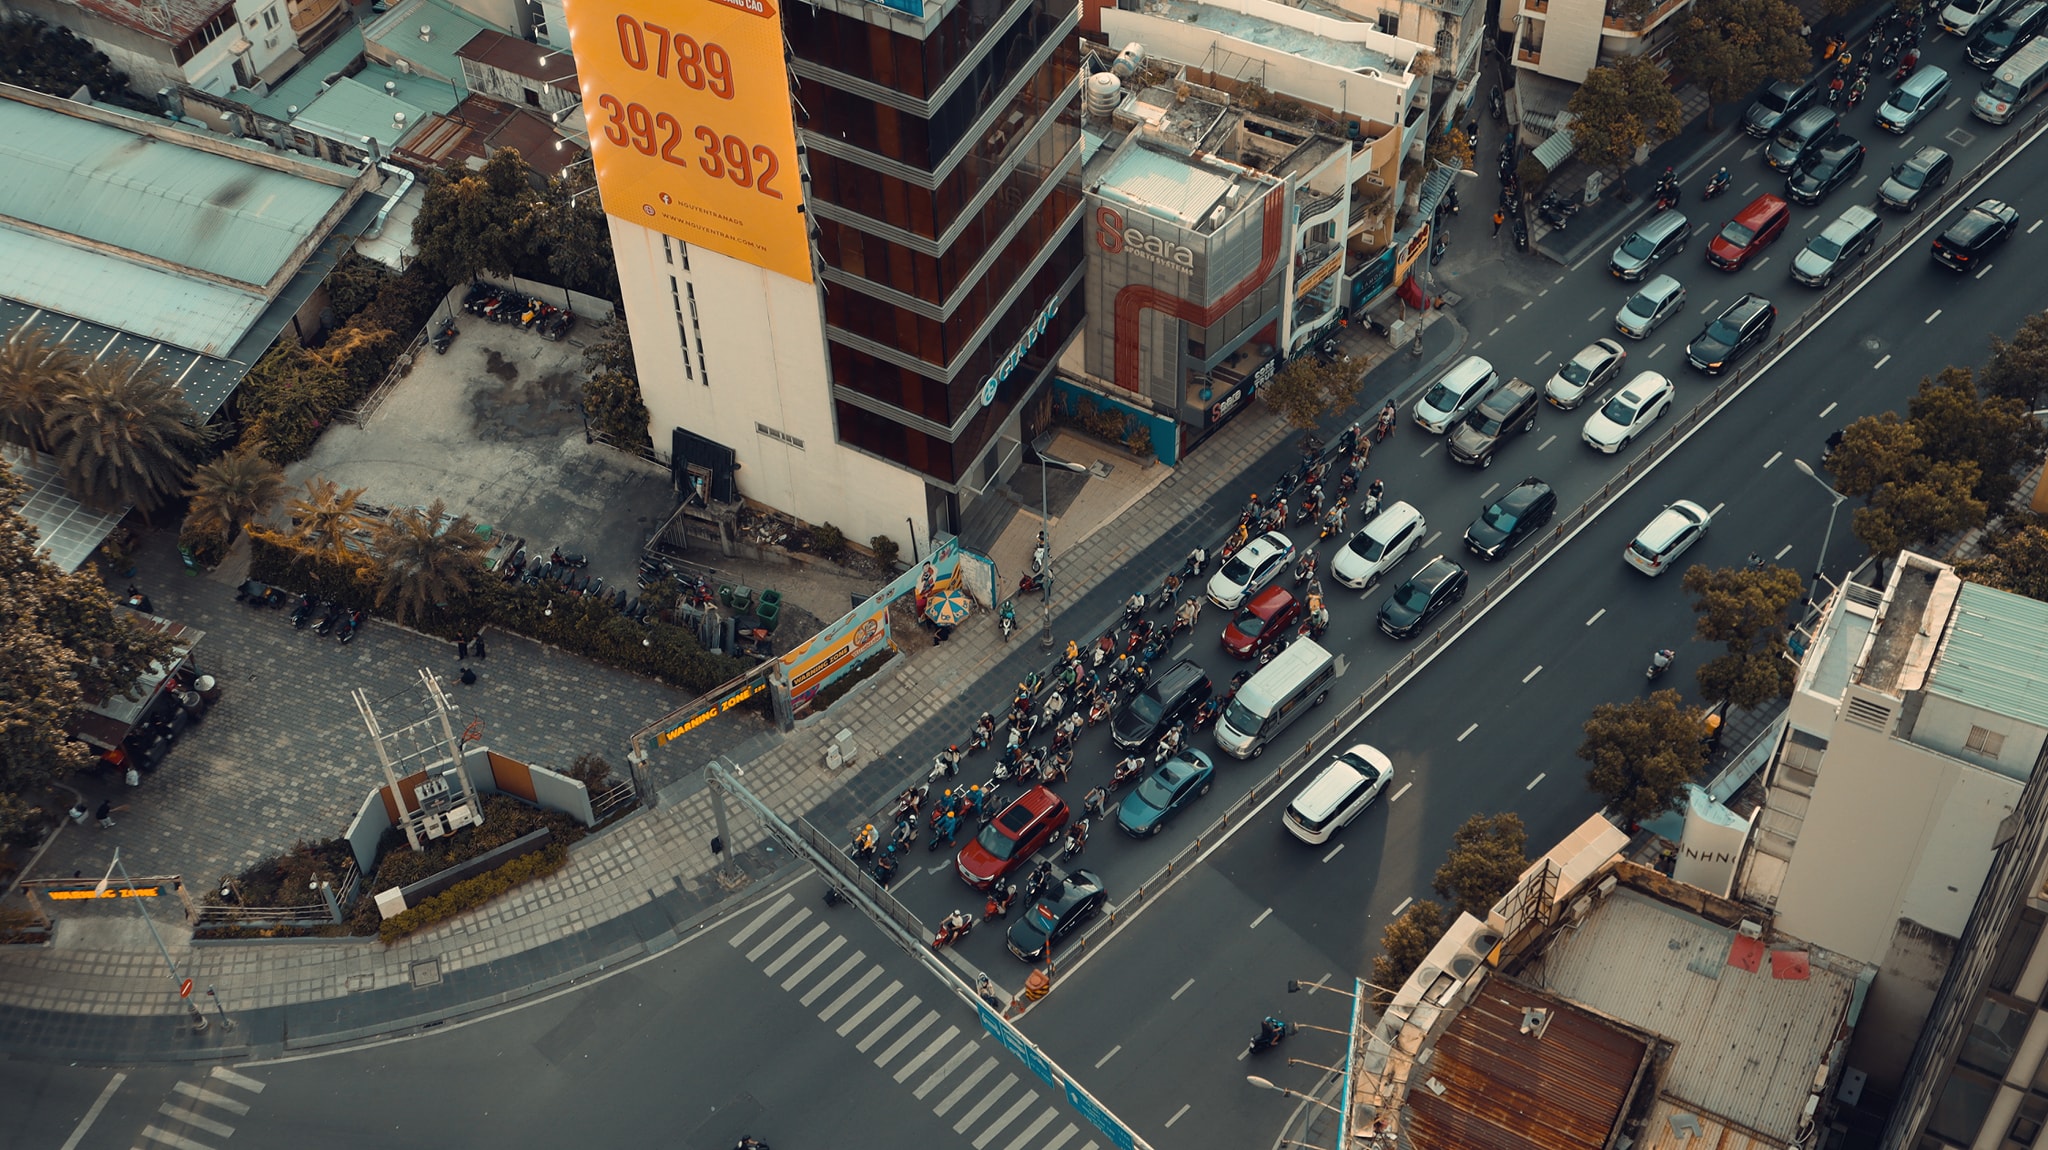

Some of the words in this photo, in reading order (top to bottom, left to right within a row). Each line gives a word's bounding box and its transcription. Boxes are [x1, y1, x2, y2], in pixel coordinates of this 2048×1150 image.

[616, 13, 735, 100] 0789
[599, 93, 687, 167] 392
[694, 125, 783, 200] 392
[661, 212, 767, 252] WWW.NGUYENTRAN.COM.VN
[678, 200, 744, 226] NGUYENTRANADS
[1096, 206, 1194, 268] Seara
[1124, 245, 1155, 262] SPORTS
[1155, 257, 1194, 276] SYSTEMS
[793, 661, 829, 685] WARNING
[666, 707, 719, 742] WARNING
[721, 689, 751, 712] ZONE
